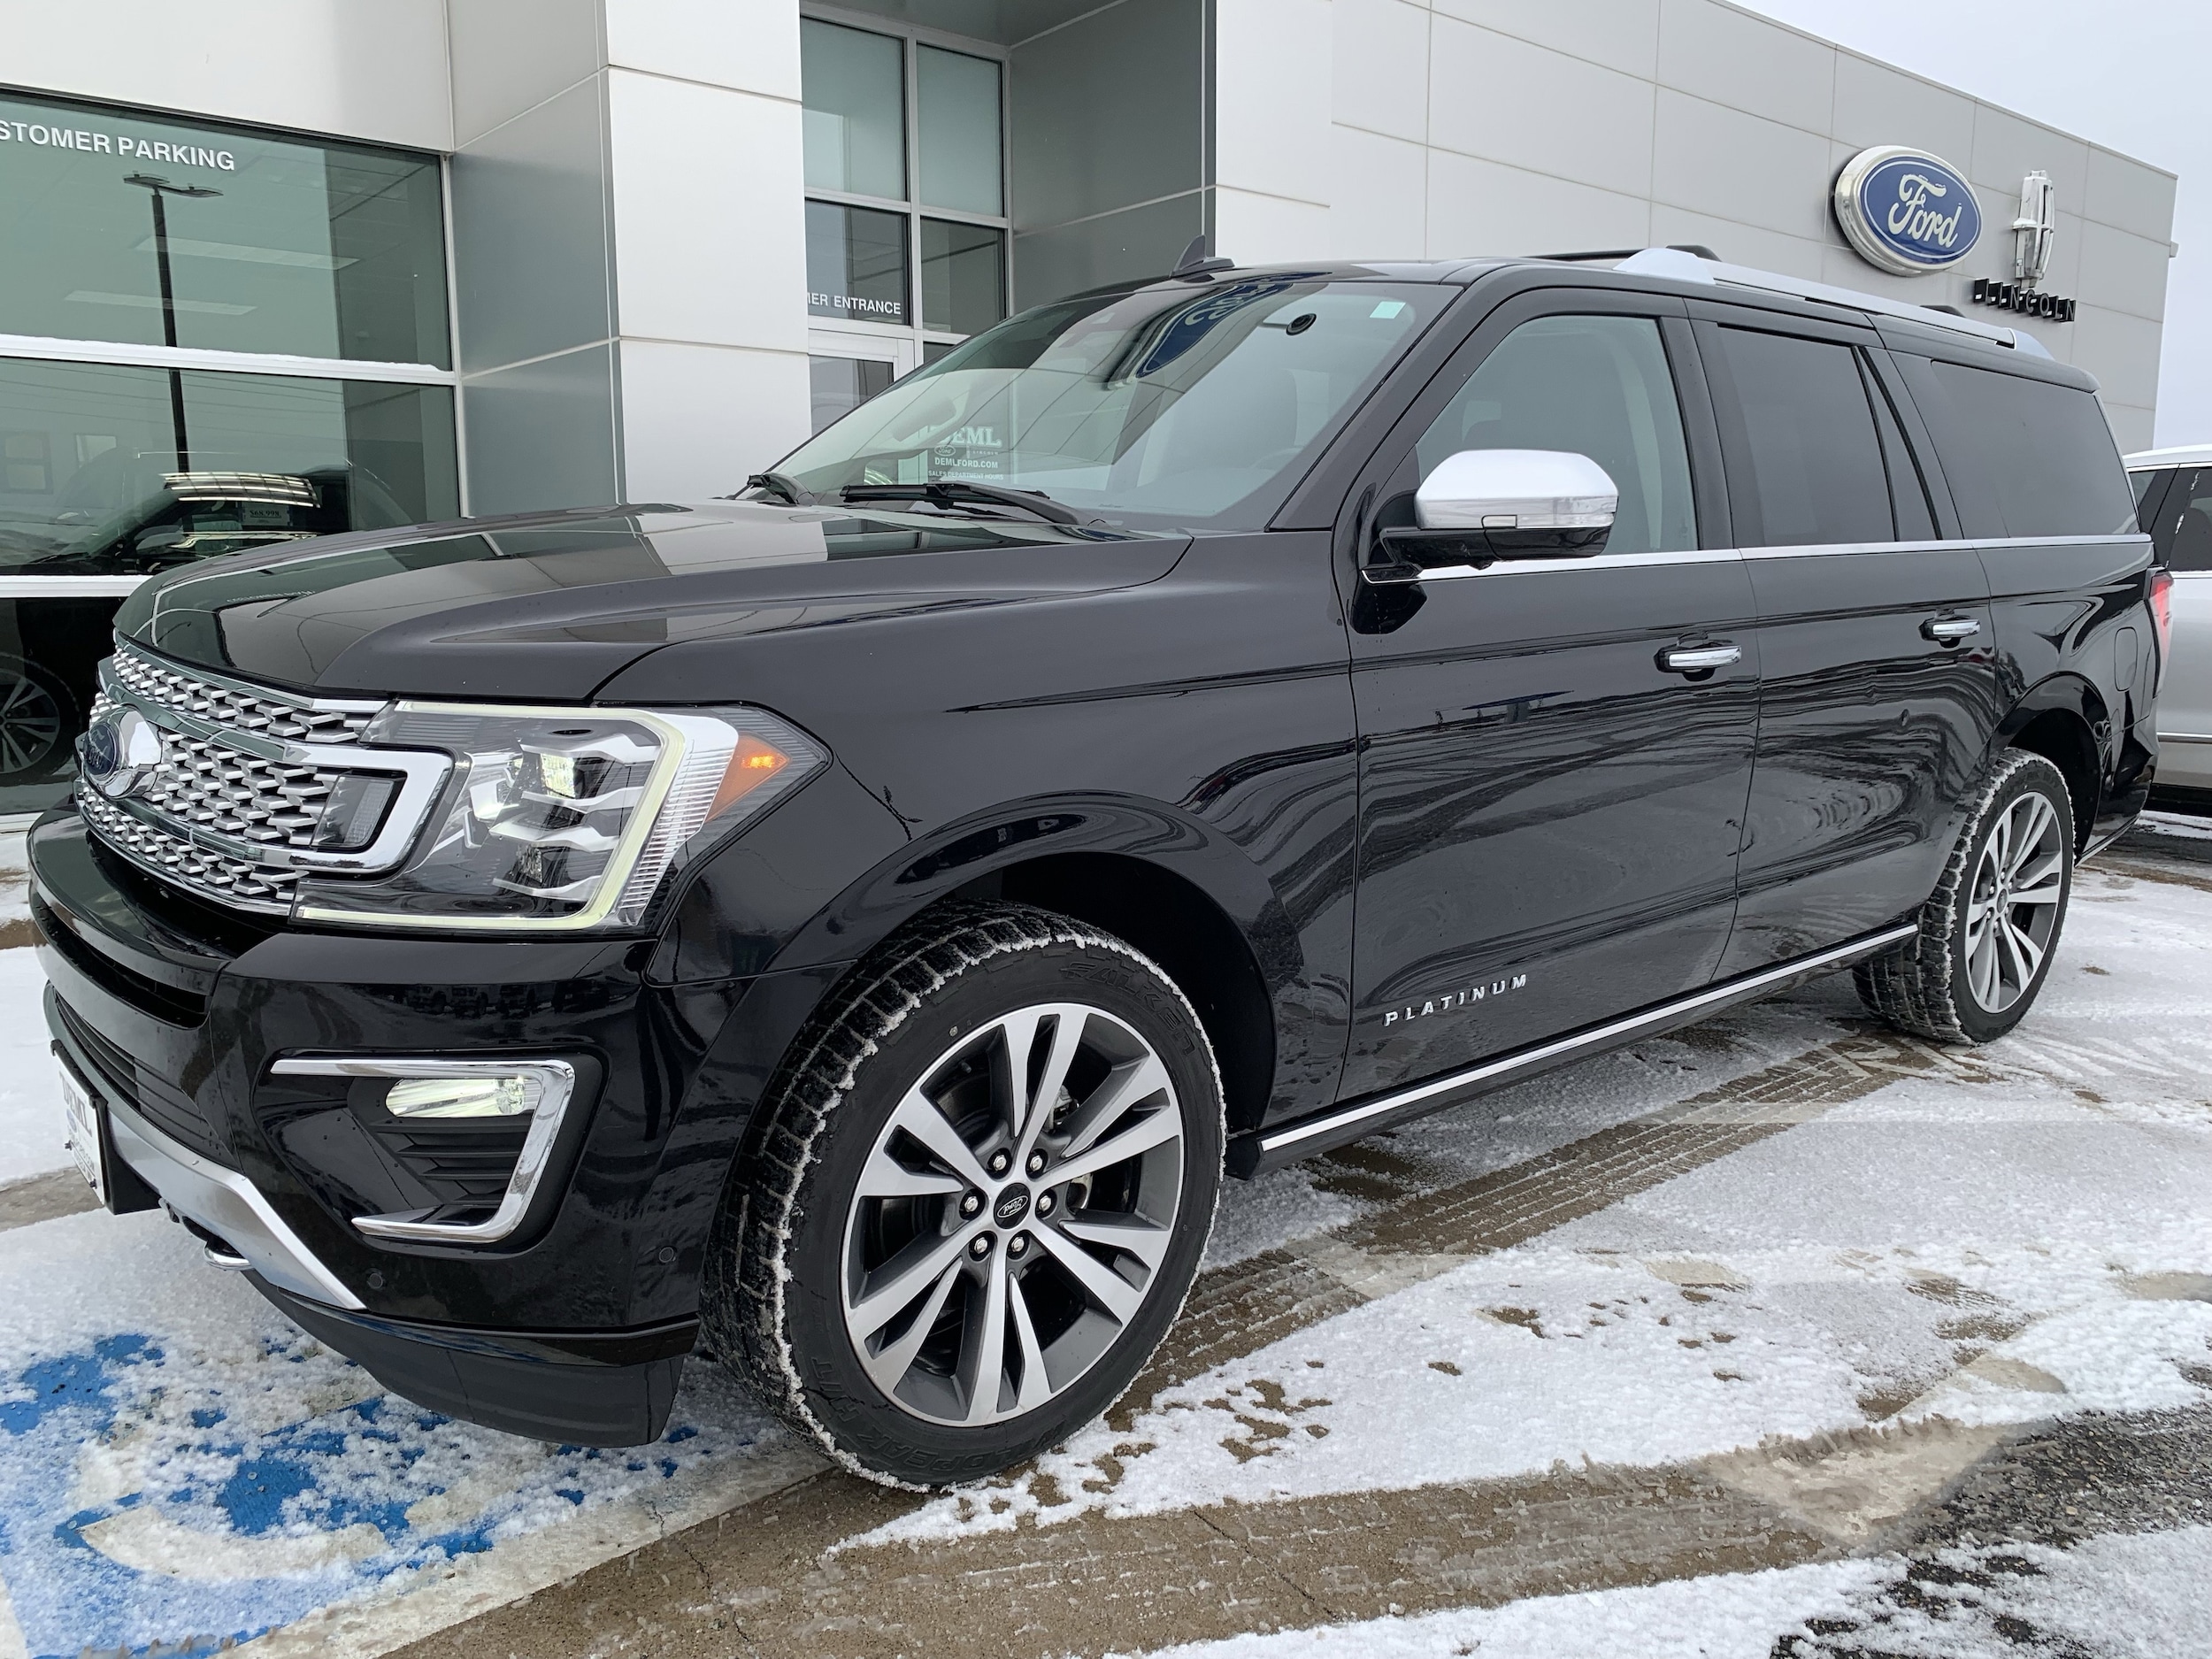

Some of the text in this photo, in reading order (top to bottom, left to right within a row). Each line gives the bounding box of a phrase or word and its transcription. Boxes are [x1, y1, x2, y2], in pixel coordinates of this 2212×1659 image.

[117, 136, 235, 172] PARKING
[1886, 173, 1963, 249] Ford
[833, 295, 902, 315] ENTRANCE
[1977, 278, 2077, 323] LINCOLN
[934, 457, 998, 468] DEMLFORD.COM
[1058, 961, 1197, 1057] FALKEN
[1382, 973, 1528, 1027] PLATINUM
